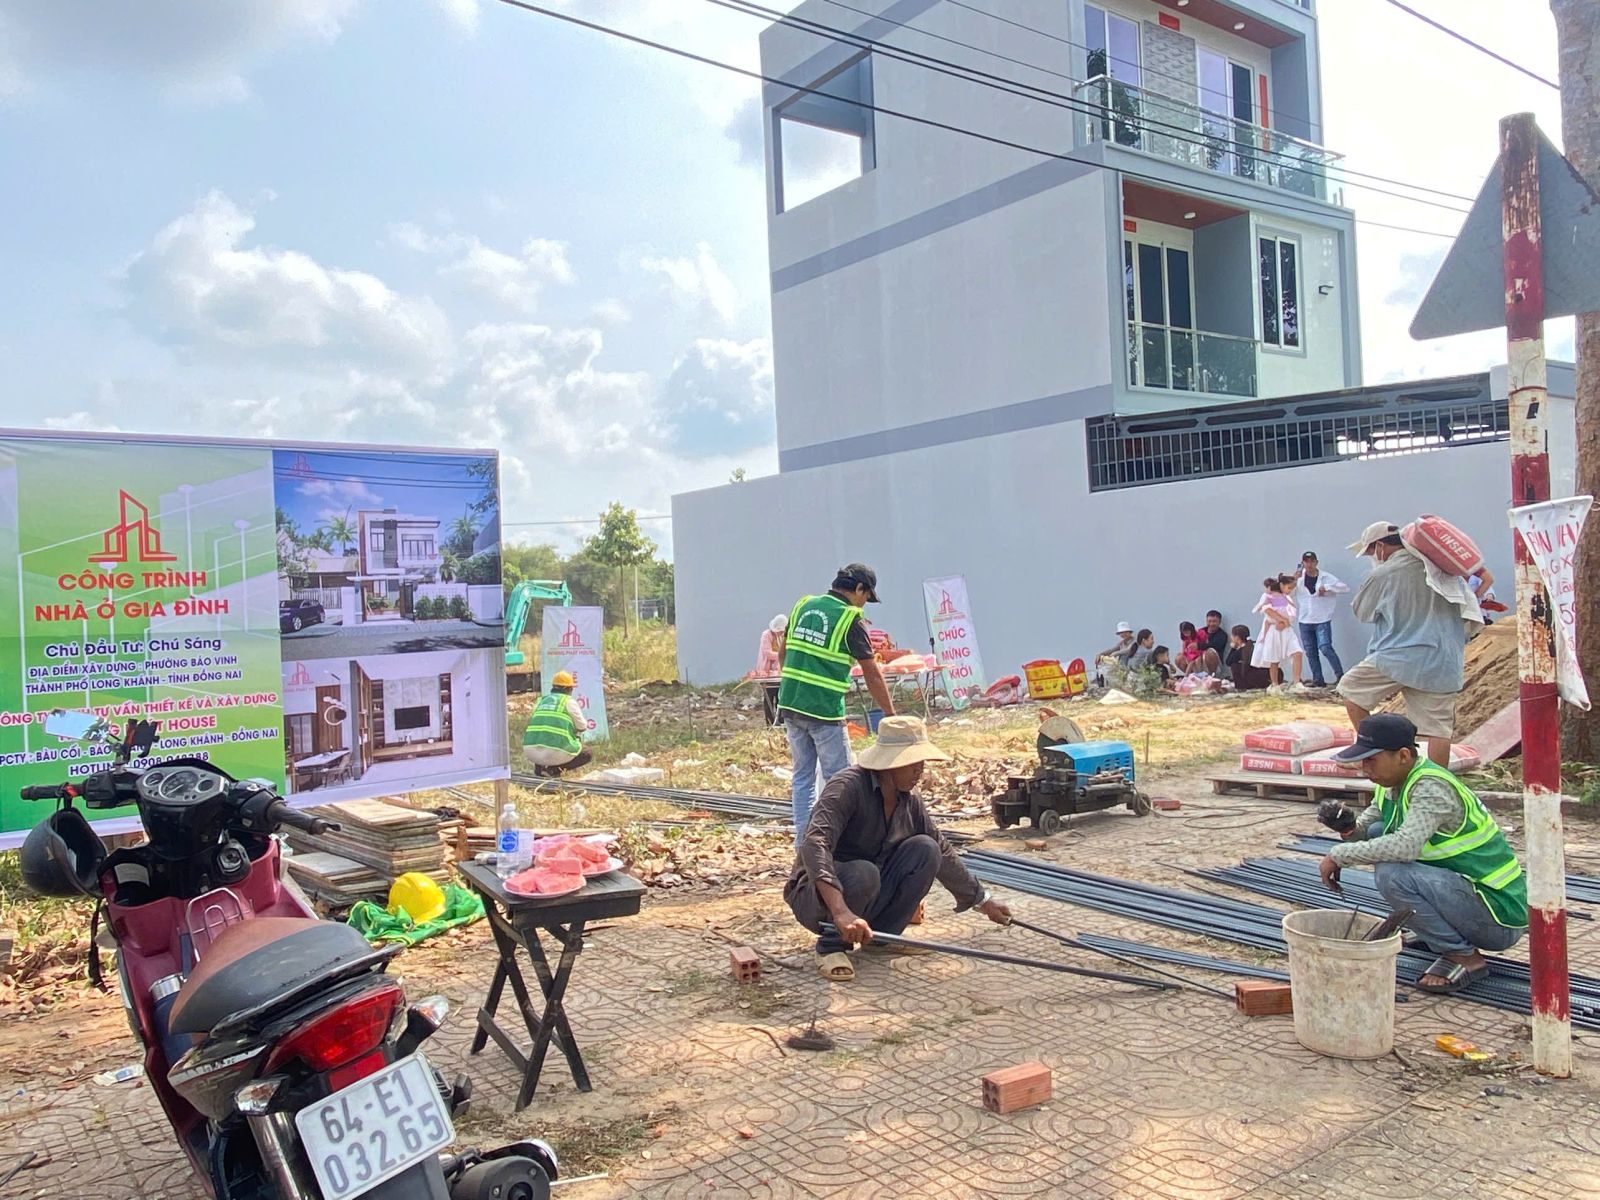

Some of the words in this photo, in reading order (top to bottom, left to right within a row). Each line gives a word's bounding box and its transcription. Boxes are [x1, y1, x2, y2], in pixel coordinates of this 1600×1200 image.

[1440, 533, 1472, 561] INSEE
[58, 570, 134, 591] CÔNG
[141, 568, 207, 588] TRÌNH
[35, 598, 89, 622] NHÀ
[97, 597, 116, 619] Ở
[123, 601, 166, 618] GIA
[174, 597, 229, 616] ĐÌNH
[938, 626, 966, 641] CHÚC
[46, 643, 79, 657] Chủ
[85, 639, 116, 655] Đầu
[122, 641, 143, 653] Tư:
[149, 638, 179, 652] Chú
[184, 637, 221, 651] Sáng
[941, 645, 971, 661] MỪNG
[30, 667, 49, 679] ĐỊA
[52, 661, 78, 676] ĐIỂM
[82, 662, 103, 674] XÂY
[106, 661, 136, 675] DỰNG
[145, 658, 188, 670] PHƯỜNG
[214, 656, 237, 665] VINH
[949, 663, 972, 679] KHỞI
[26, 681, 62, 694] THÀNH
[66, 676, 88, 691] PHỐ
[92, 679, 120, 689] LONG
[124, 674, 160, 687] KHÁNH
[193, 669, 222, 682] ĐỒNG
[225, 670, 242, 679] NAI
[0, 712, 33, 725] ÔNG
[95, 705, 110, 717] TƯ
[113, 701, 140, 715] VẤN
[144, 698, 174, 713] THIẾT
[178, 696, 193, 710] KẾ
[196, 696, 213, 708] VÀ
[217, 694, 240, 706] XÂY
[243, 693, 277, 706] DỰNG
[168, 716, 216, 731] HOUSE
[36, 749, 57, 761] BÀU
[60, 745, 80, 759] CỐI
[160, 737, 187, 749] LONG
[190, 733, 223, 746] KHÁNH
[231, 728, 259, 741] ĐỒNG
[262, 729, 278, 738] NAI
[1248, 759, 1274, 769] INSEE
[319, 1069, 414, 1144] 64-E1
[323, 1101, 444, 1194] 032.65
